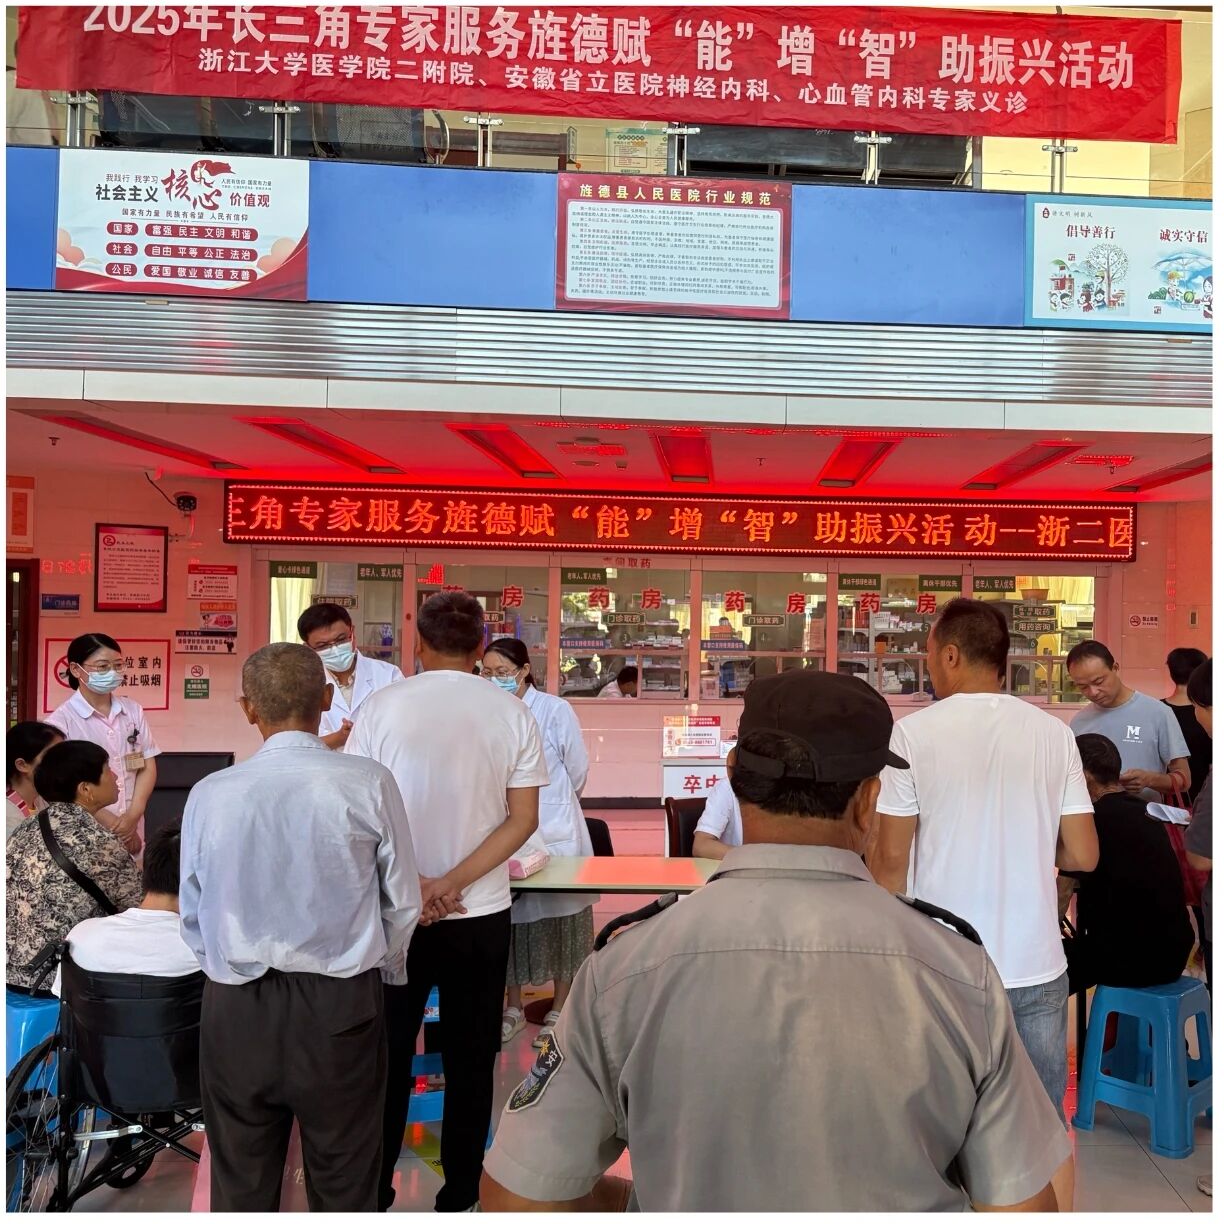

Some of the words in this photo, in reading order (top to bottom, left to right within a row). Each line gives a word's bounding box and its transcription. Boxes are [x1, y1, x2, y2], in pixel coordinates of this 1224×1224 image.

[198, 47, 1028, 115] 浙江大学医学院二附院、安徽省立医院神经内科、心血管内科专家义诊
[106, 173, 131, 183] 我践行
[134, 174, 158, 184] 我学习
[95, 185, 159, 203] 社会主义
[229, 192, 270, 208] 价值观
[580, 184, 772, 206] 旌德县人民医院行业规范
[122, 208, 160, 218] 国家有力量
[166, 210, 204, 220] 民族有希望
[209, 212, 249, 222] 人民有信仰
[113, 224, 133, 234] 国家
[152, 225, 173, 236] 富强
[178, 226, 199, 237] 民主
[205, 227, 225, 239] 文明
[231, 229, 251, 240] 和谐
[1066, 224, 1116, 239] 倡导善行
[1159, 228, 1209, 244] 诚实守信
[112, 244, 133, 254] 社会
[151, 246, 172, 256] 自由
[178, 247, 198, 258] 平等
[204, 248, 225, 259] 公正
[230, 249, 251, 260] 法治
[112, 264, 132, 275] 公民
[151, 266, 171, 277] 爱国
[178, 267, 198, 278] 敬业
[204, 268, 224, 279] 诚信
[230, 269, 250, 281] 友善
[502, 585, 523, 608] 房
[588, 587, 611, 609] 药
[641, 588, 661, 609] 房
[725, 592, 745, 613] 药
[787, 594, 806, 614] 房
[860, 593, 880, 613] 药
[916, 593, 937, 614] 房
[607, 614, 641, 624] 门诊取药
[747, 616, 782, 625] 门诊取药
[1126, 725, 1141, 739] M
